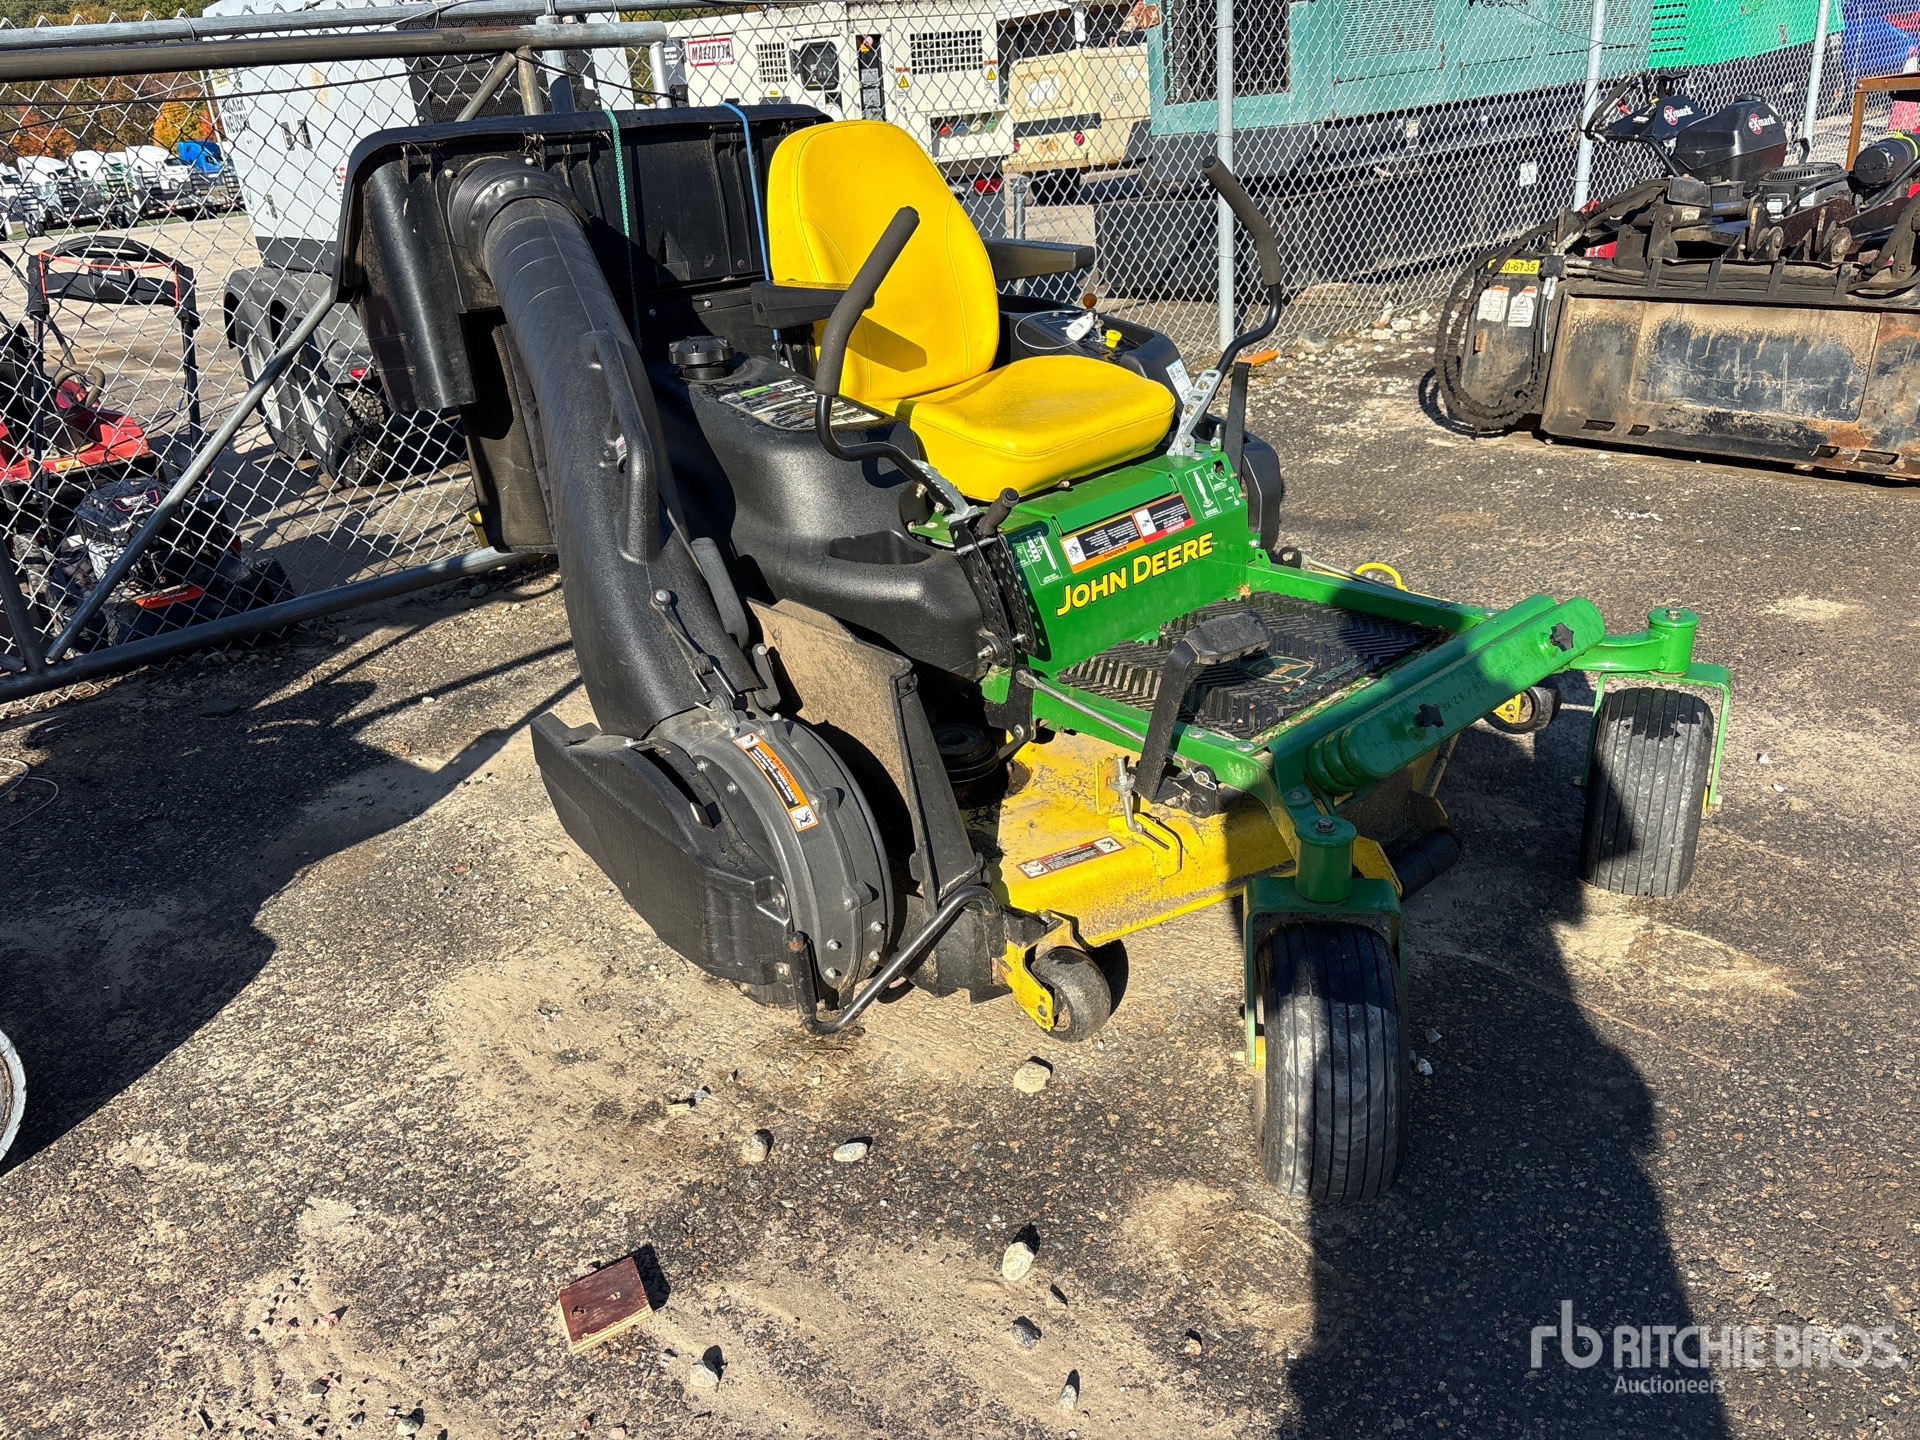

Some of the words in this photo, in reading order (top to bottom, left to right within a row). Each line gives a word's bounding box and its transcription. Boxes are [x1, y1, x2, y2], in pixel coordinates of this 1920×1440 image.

[1056, 565, 1128, 617] JOHN
[1133, 532, 1213, 585] DEERE
[773, 759, 795, 784] WARNING
